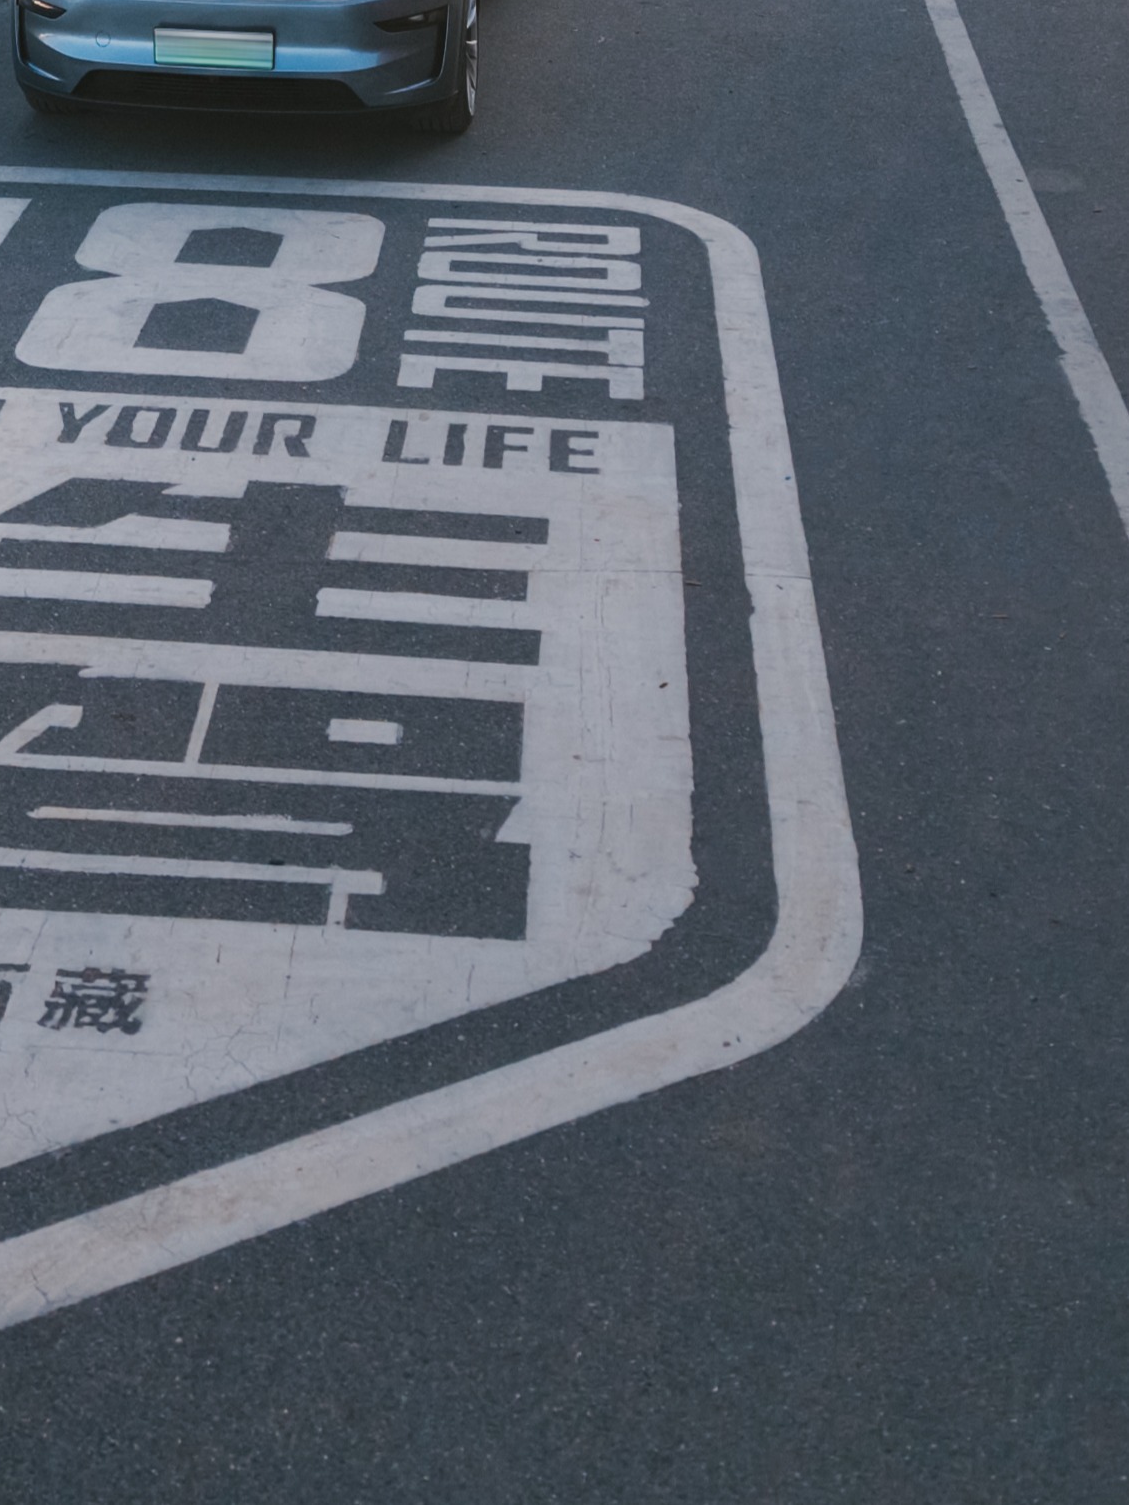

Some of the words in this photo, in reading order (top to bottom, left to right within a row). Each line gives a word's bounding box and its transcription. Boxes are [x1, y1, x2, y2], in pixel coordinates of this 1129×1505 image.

[397, 216, 649, 401] ROUTE
[57, 401, 318, 460] YOUR
[382, 417, 604, 477] LIFE
